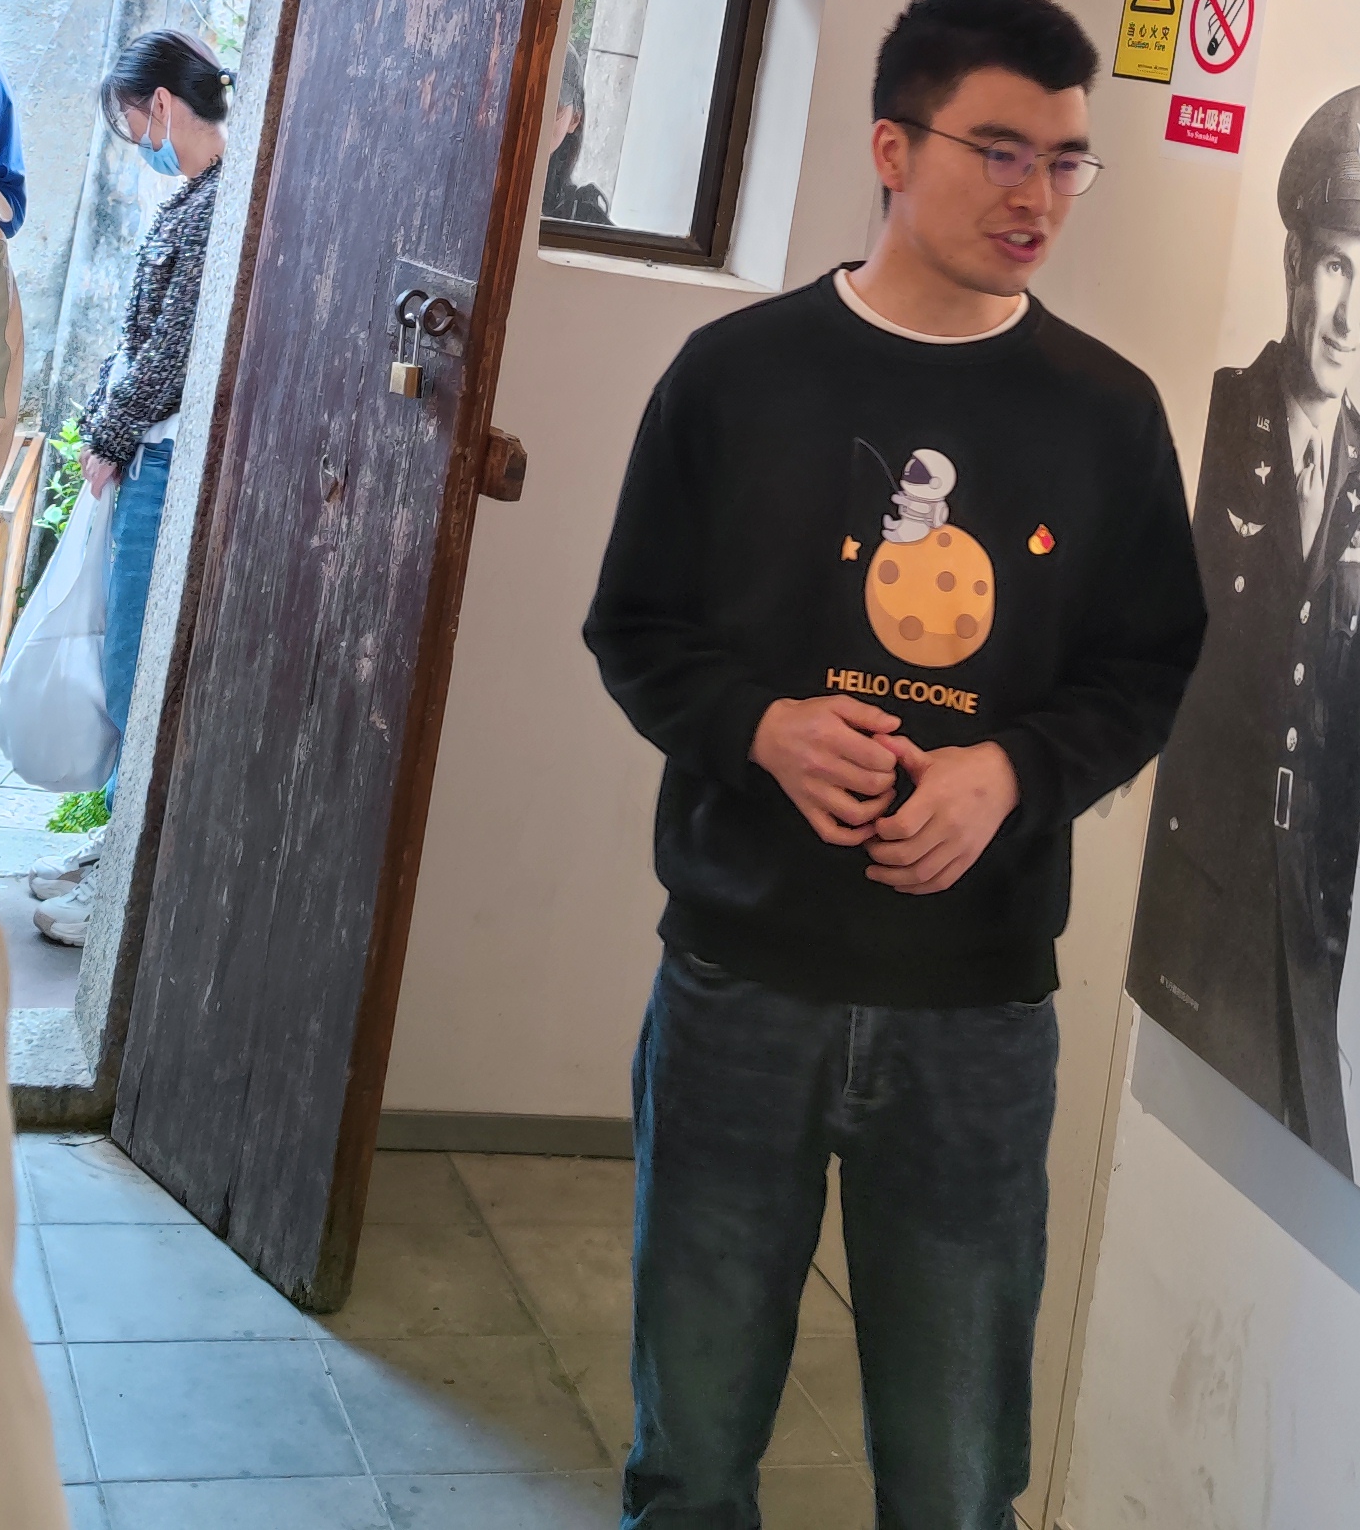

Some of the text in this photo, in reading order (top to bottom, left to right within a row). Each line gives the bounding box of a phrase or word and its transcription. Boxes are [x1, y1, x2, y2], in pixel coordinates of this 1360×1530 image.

[1127, 22, 1170, 40] 当心火灾
[1178, 103, 1233, 135] 禁止吸烟
[1194, 132, 1218, 144] Smoking
[826, 667, 980, 715] HELLO COOKIE
